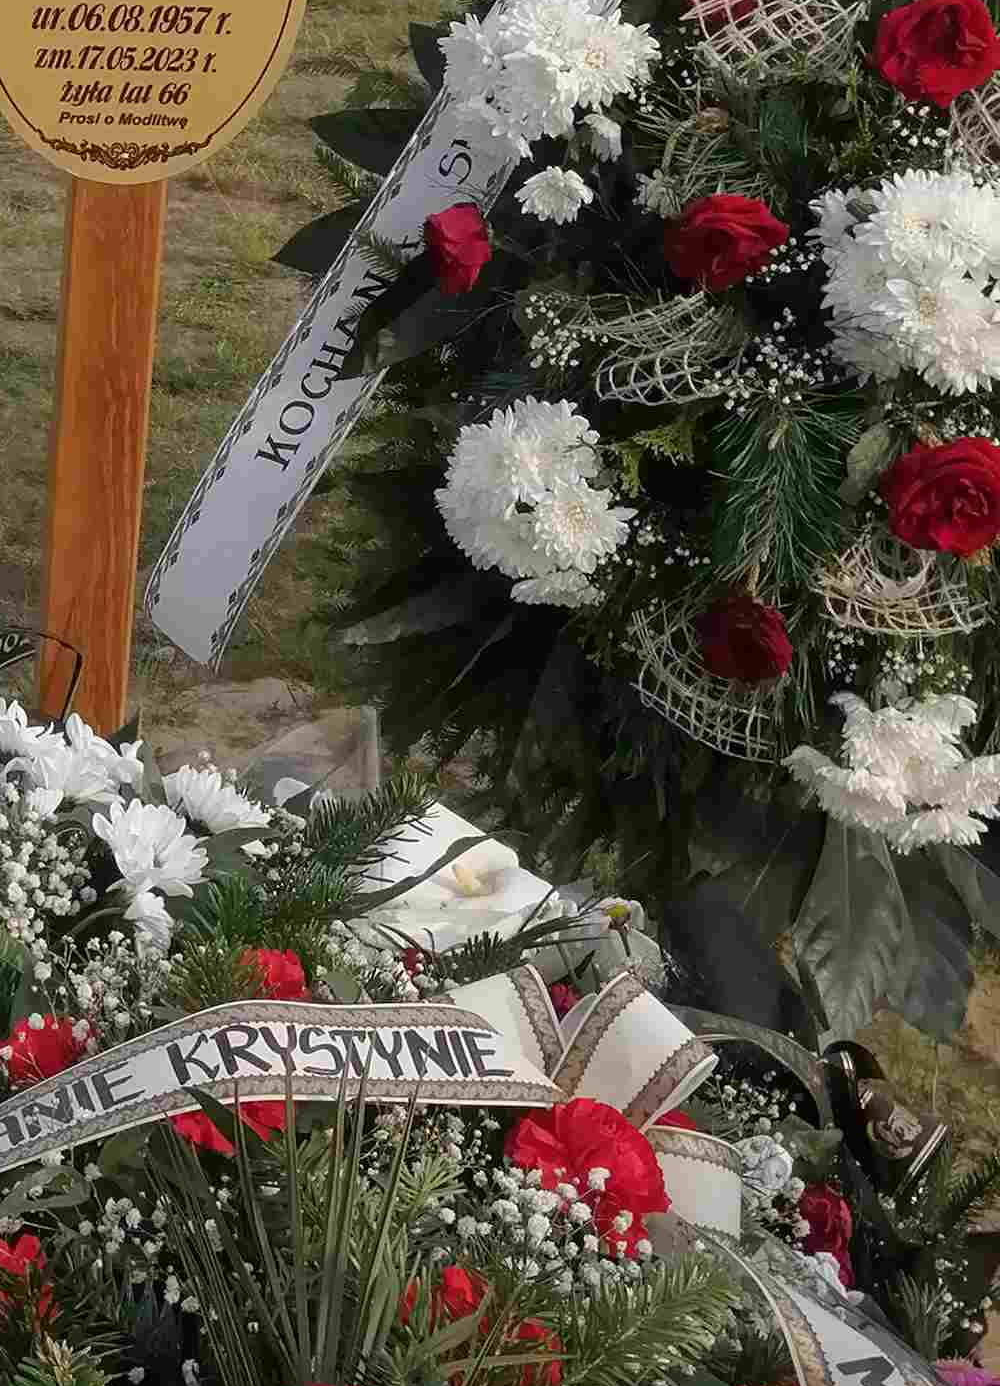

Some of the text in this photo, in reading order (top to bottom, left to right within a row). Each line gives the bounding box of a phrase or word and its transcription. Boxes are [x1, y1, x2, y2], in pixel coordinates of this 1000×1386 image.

[31, 3, 232, 35] ur.06.08.1957 r.
[34, 45, 217, 73] zm.17.05.2023 r.
[118, 81, 153, 103] lat
[158, 82, 191, 105] 66
[58, 111, 189, 129] Prosi o Modlitwę
[166, 1022, 514, 1086] KRYSTYNIE
